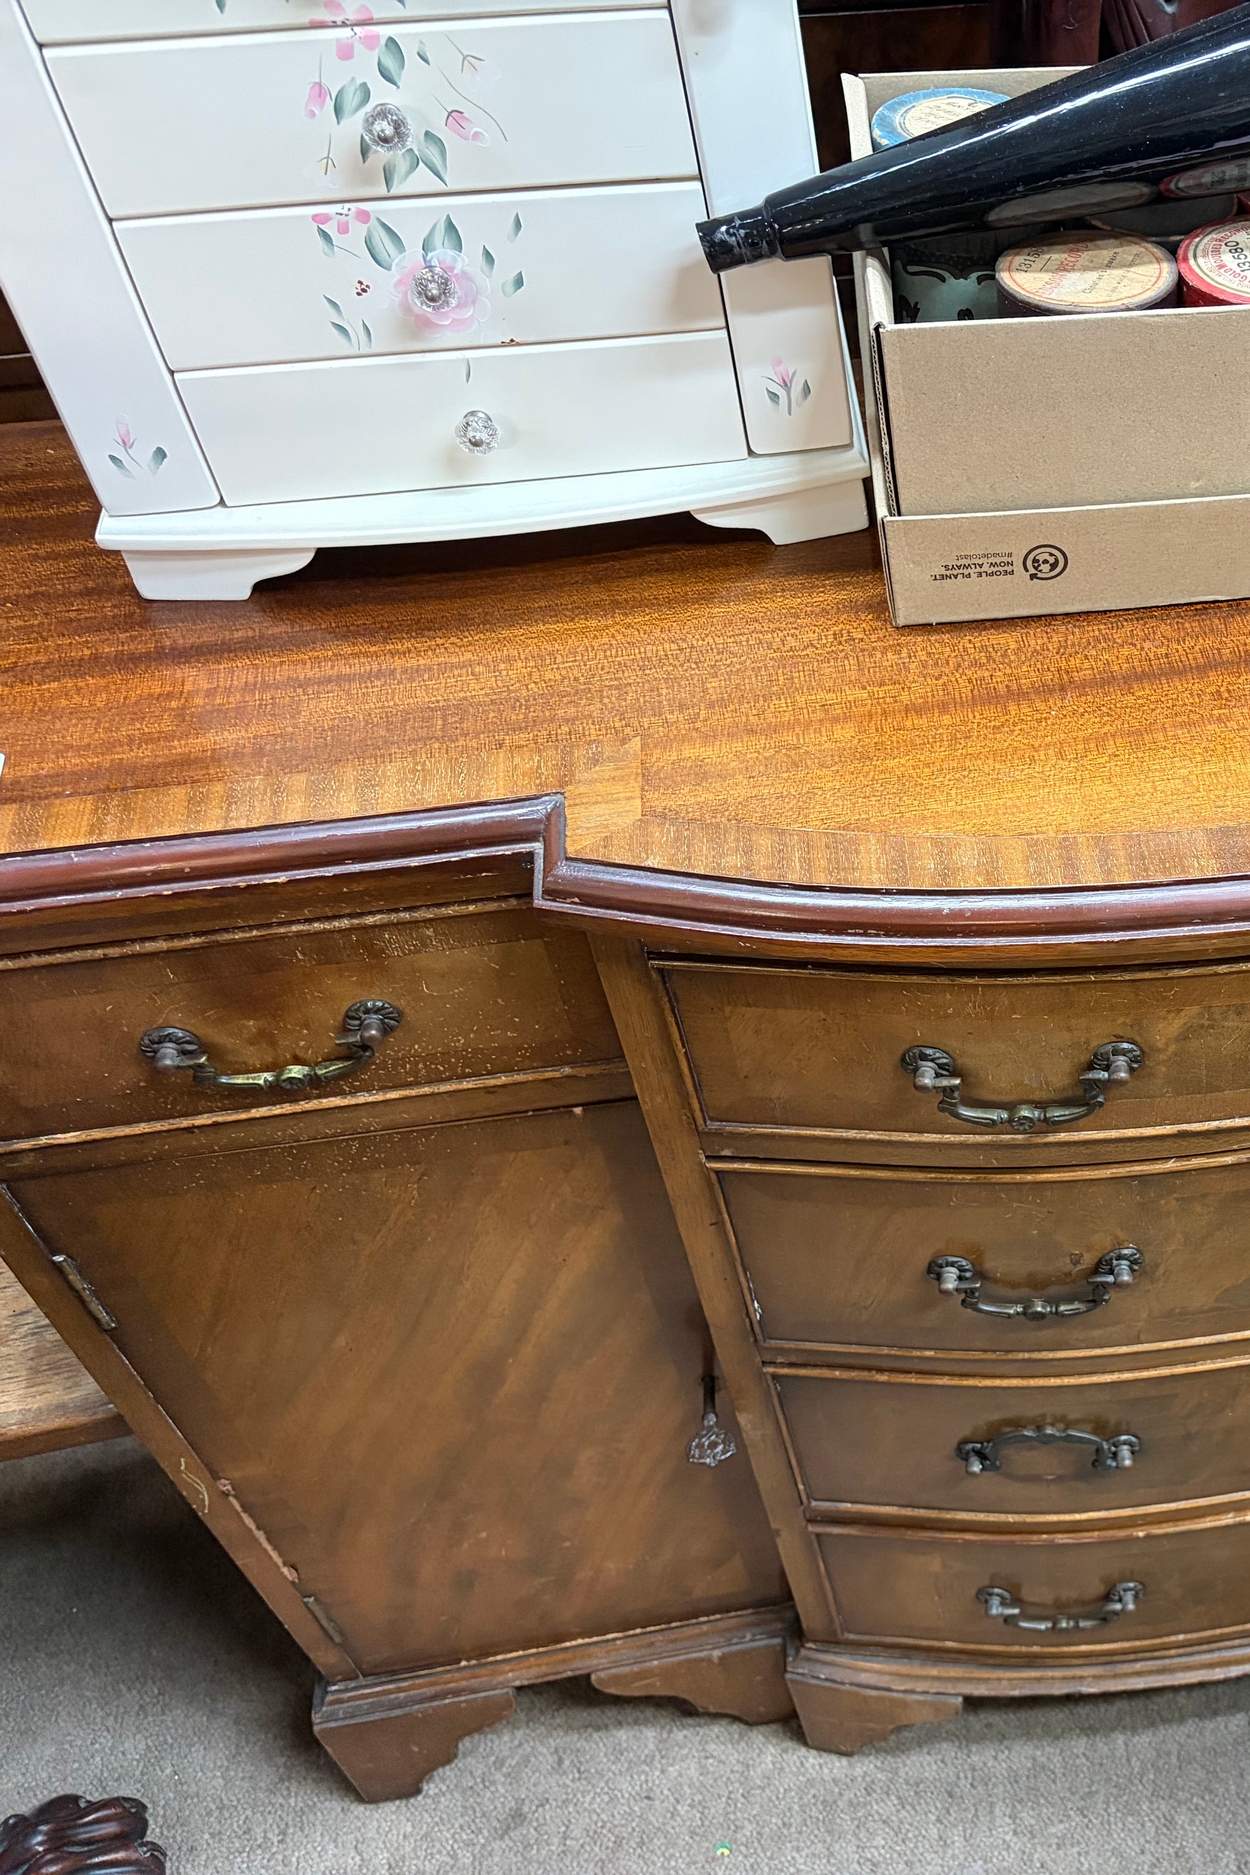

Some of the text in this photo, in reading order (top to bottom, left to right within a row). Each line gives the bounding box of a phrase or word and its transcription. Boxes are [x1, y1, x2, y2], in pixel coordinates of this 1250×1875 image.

[1015, 246, 1045, 273] 13158
[955, 551, 1013, 561] #madetolast
[941, 560, 1014, 571] NOW. ALWAYS.
[930, 569, 1015, 581] PEOPLE. PLANET.
